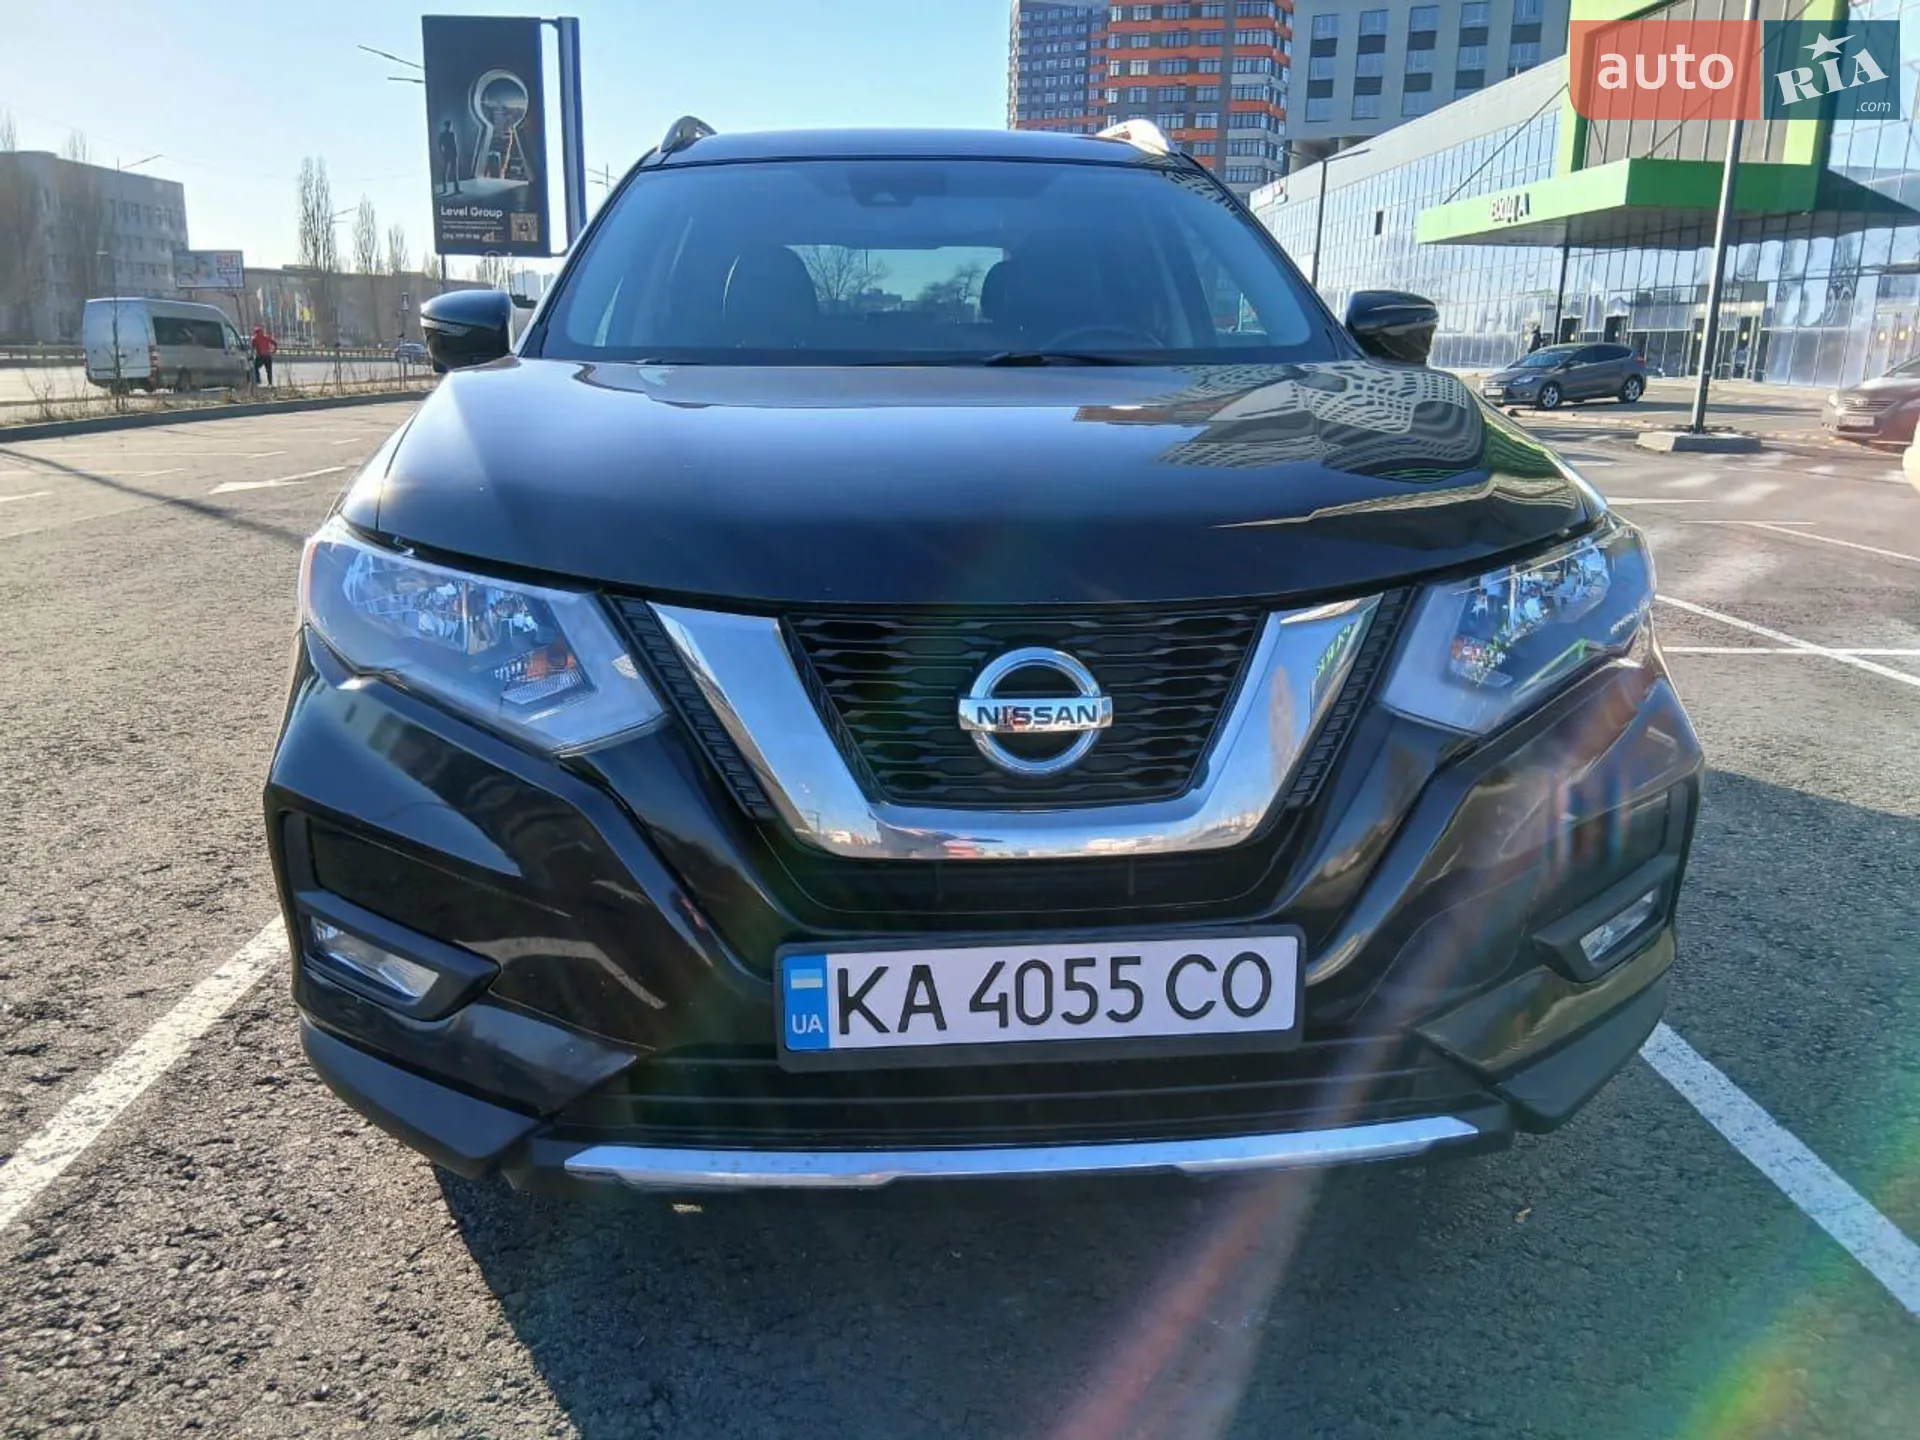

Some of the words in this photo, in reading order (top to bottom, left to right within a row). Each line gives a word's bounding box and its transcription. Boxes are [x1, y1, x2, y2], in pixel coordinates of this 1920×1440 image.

[440, 205, 468, 217] Level
[470, 207, 503, 219] Group
[976, 705, 1098, 725] NISSAN
[837, 963, 947, 1035] KA
[969, 956, 1144, 1028] 4055
[1165, 951, 1272, 1020] CO
[792, 1014, 824, 1035] UA
